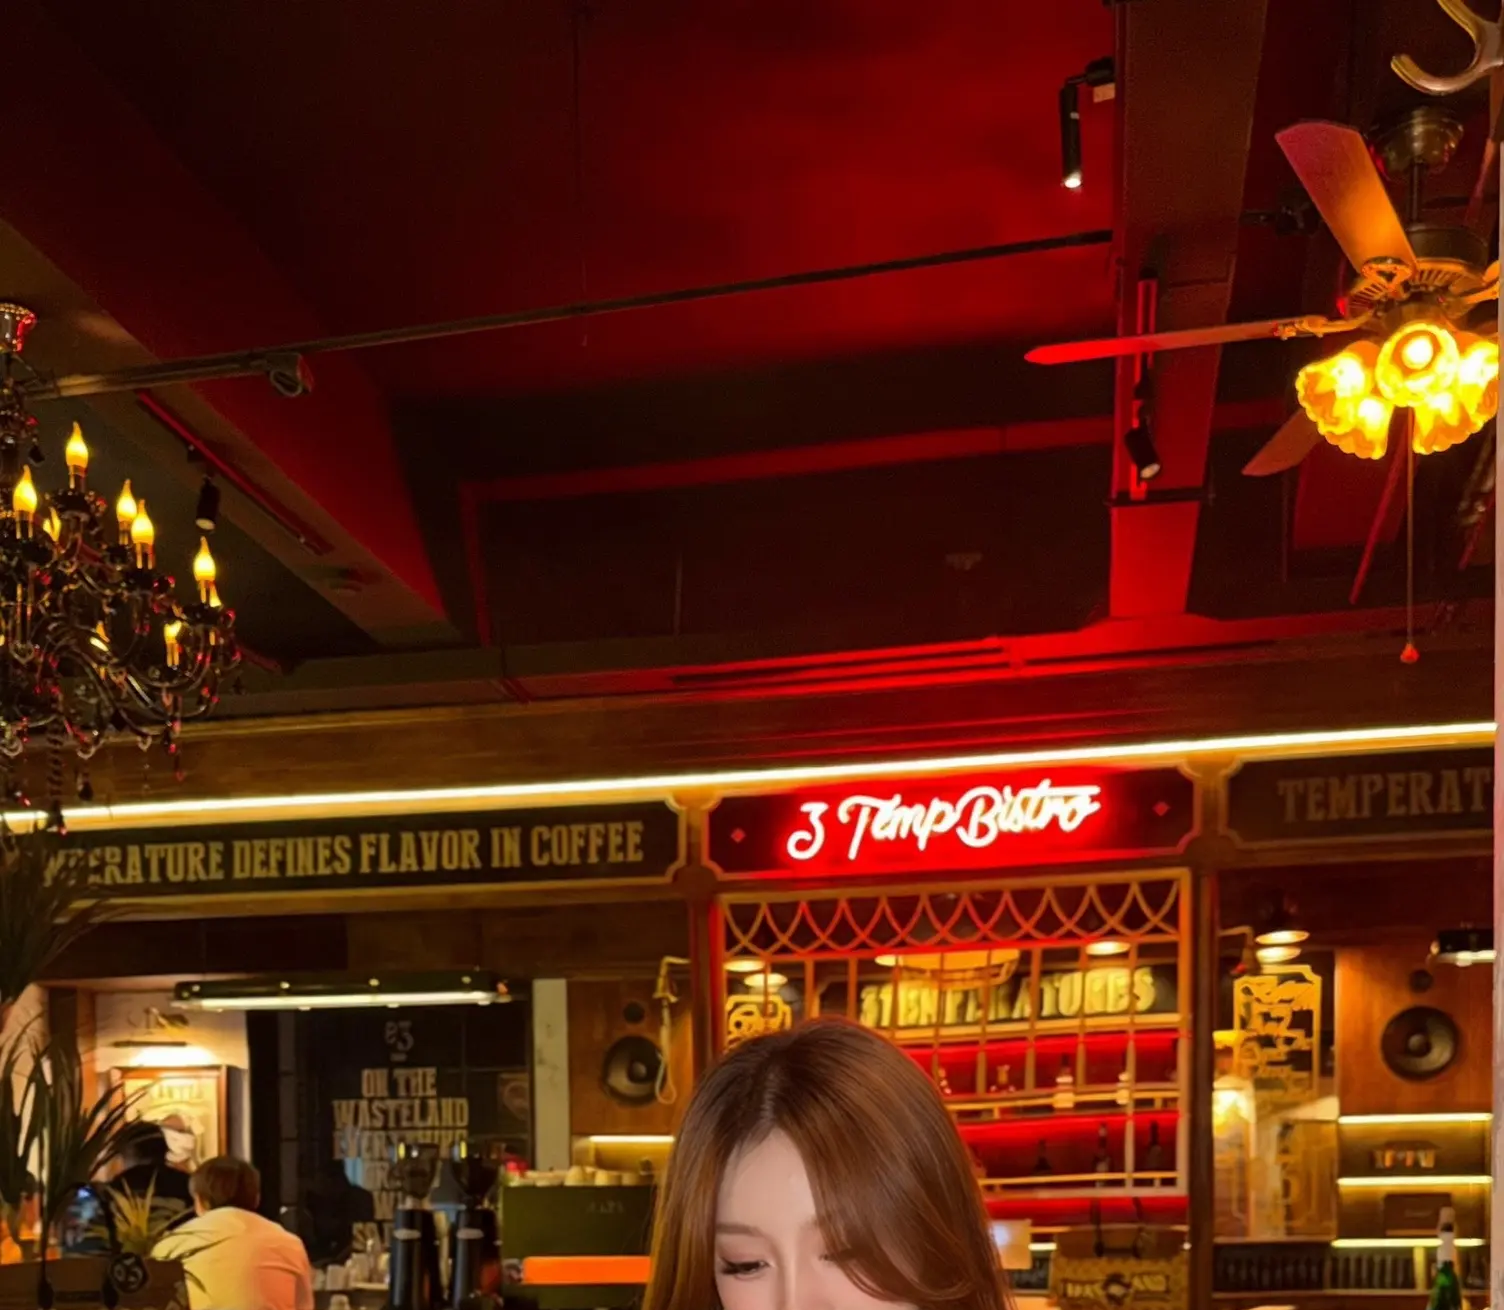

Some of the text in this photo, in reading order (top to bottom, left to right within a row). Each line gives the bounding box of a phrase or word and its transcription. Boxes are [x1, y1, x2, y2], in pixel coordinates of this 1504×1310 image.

[1277, 766, 1492, 823] TEMPERAT
[232, 835, 352, 879] DEFINES
[359, 829, 482, 874] FLAVOR
[490, 826, 522, 868] IN
[530, 820, 644, 866] COFFEE
[361, 1067, 437, 1097] ON THE
[331, 1098, 469, 1128] WASTELAND
